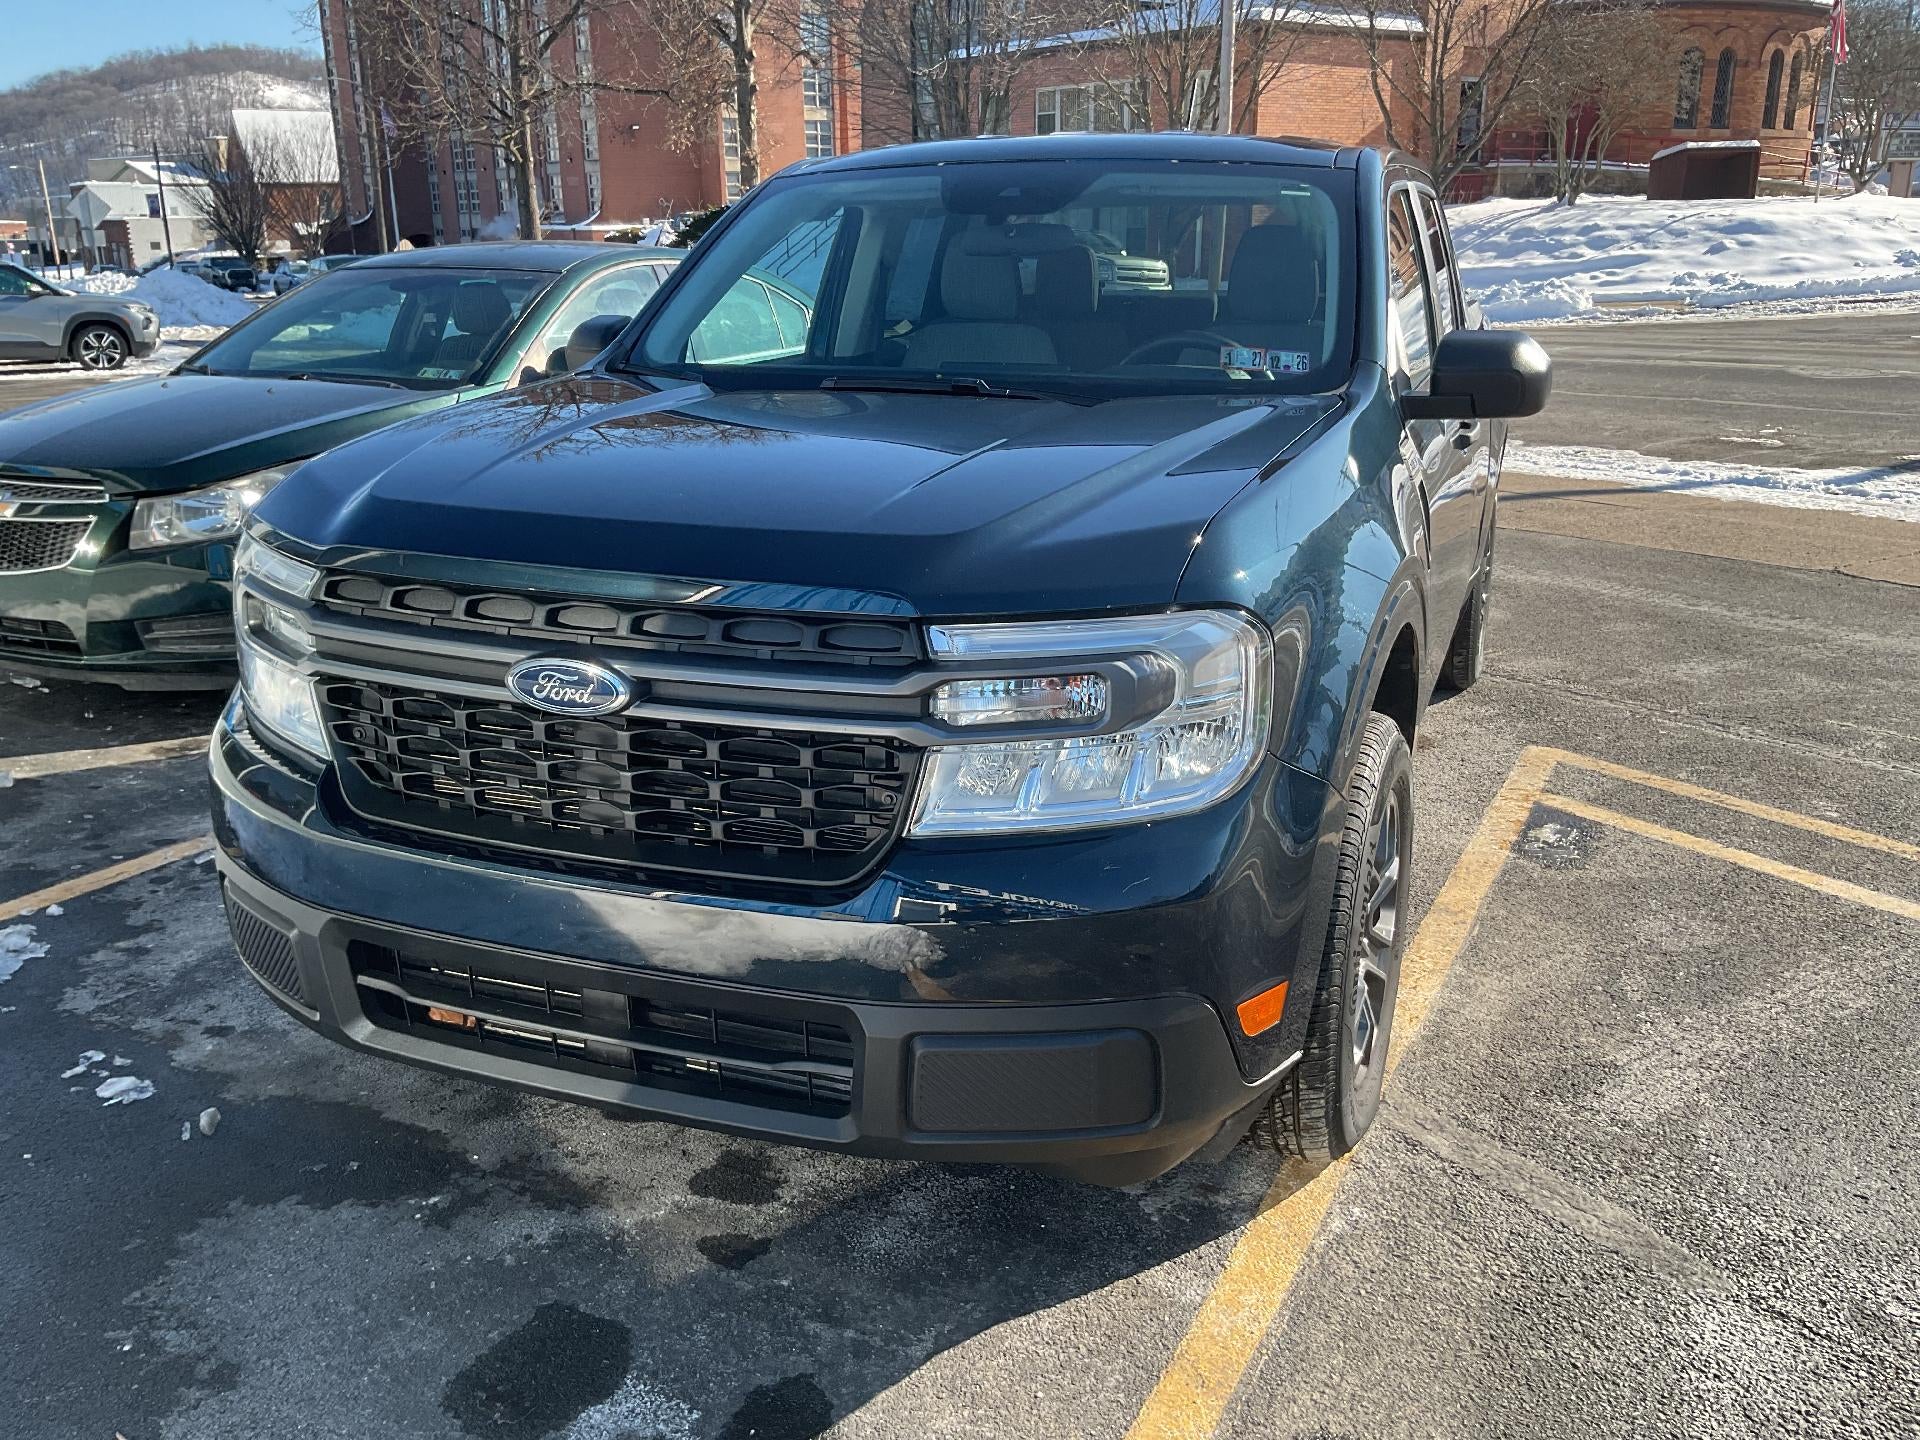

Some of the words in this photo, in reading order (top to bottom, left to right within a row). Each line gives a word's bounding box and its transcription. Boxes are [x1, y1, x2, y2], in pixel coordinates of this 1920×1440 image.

[1252, 351, 1262, 367] 27
[1270, 355, 1280, 369] 12
[1297, 354, 1307, 370] 26
[532, 671, 595, 704] Ford
